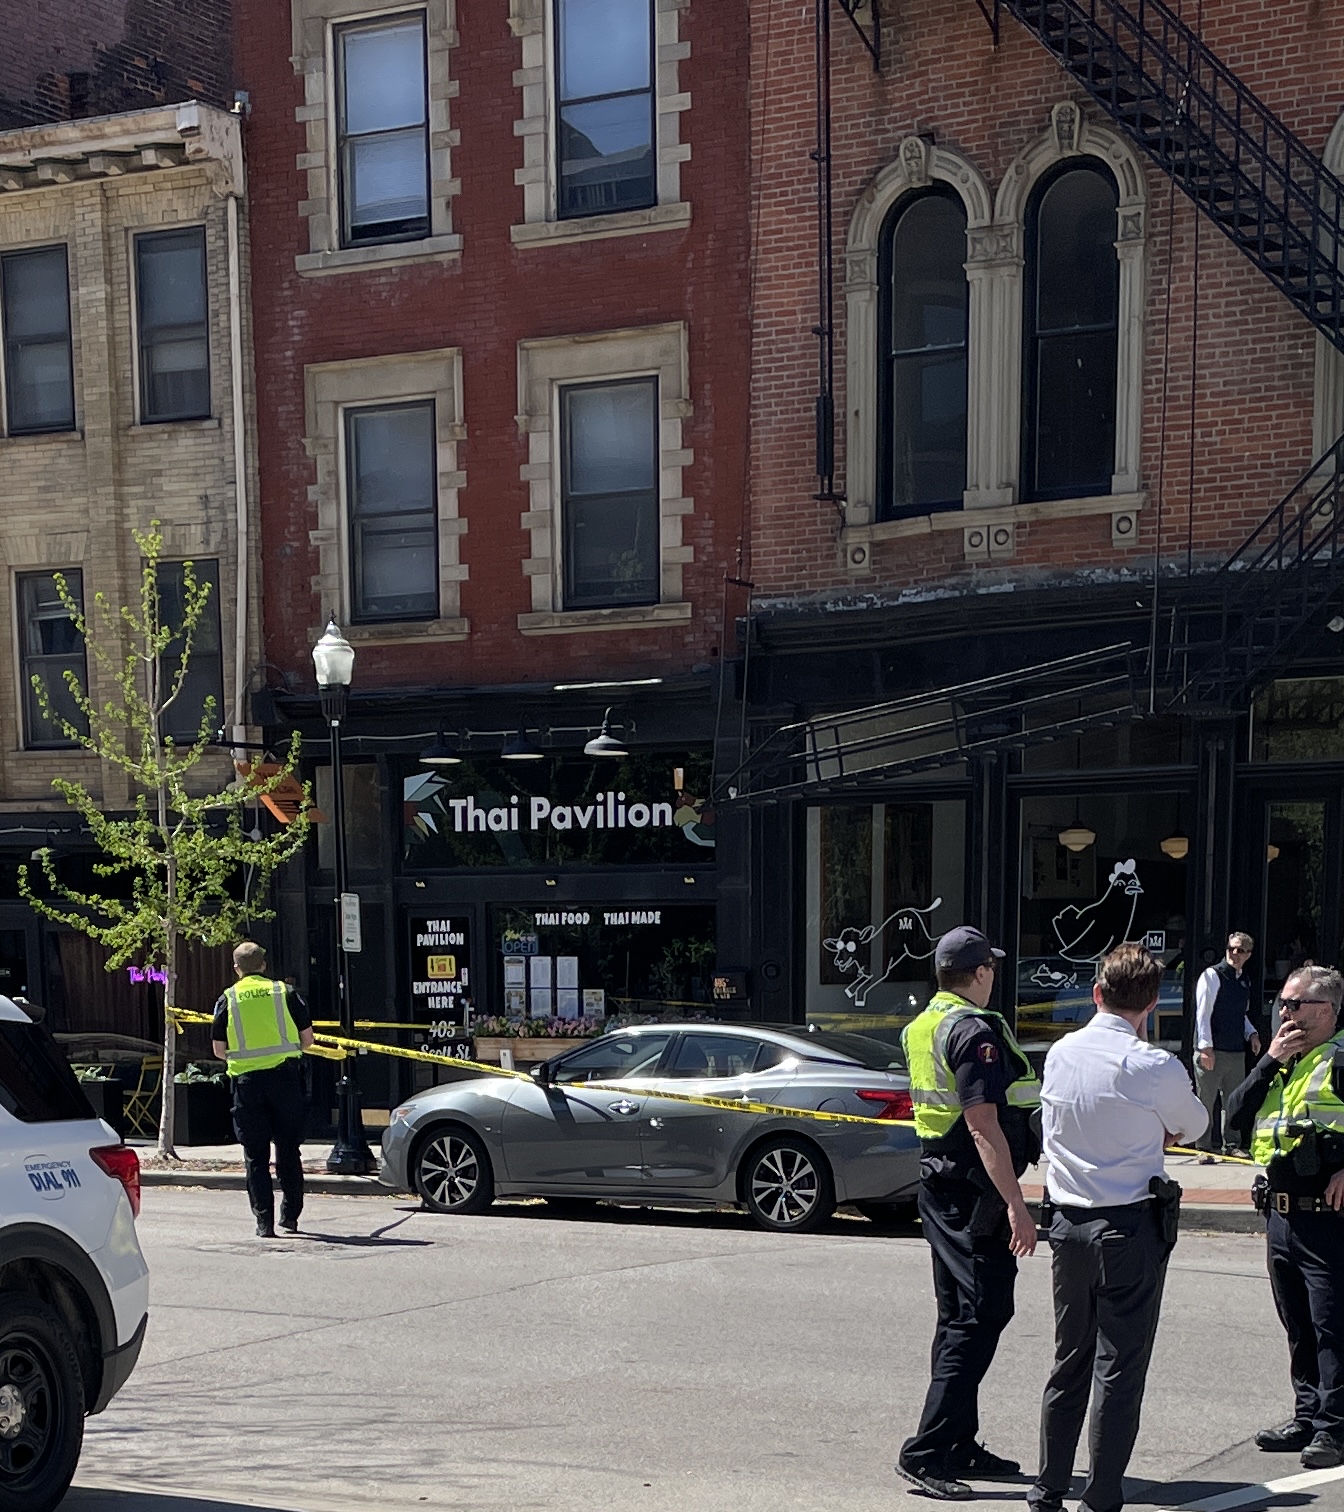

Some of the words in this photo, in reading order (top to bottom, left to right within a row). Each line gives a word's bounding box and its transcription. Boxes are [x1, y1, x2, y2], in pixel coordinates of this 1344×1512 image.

[449, 795, 519, 832] Thai
[530, 791, 673, 830] Pavilion
[535, 913, 559, 925] THAI
[561, 912, 590, 925] FOOD
[604, 912, 630, 925] THAI
[631, 911, 661, 925] MADE
[426, 919, 451, 933] THAI
[416, 933, 464, 946] PAVILION
[505, 941, 535, 952] OPEN
[239, 988, 271, 1000] POLICE
[413, 981, 462, 994] ENTRANCE
[428, 996, 454, 1009] HERE
[429, 1020, 456, 1038] 405
[24, 1161, 72, 1172] EMERGENCY
[28, 1171, 64, 1192] DIAL
[61, 1168, 82, 1188] 911
